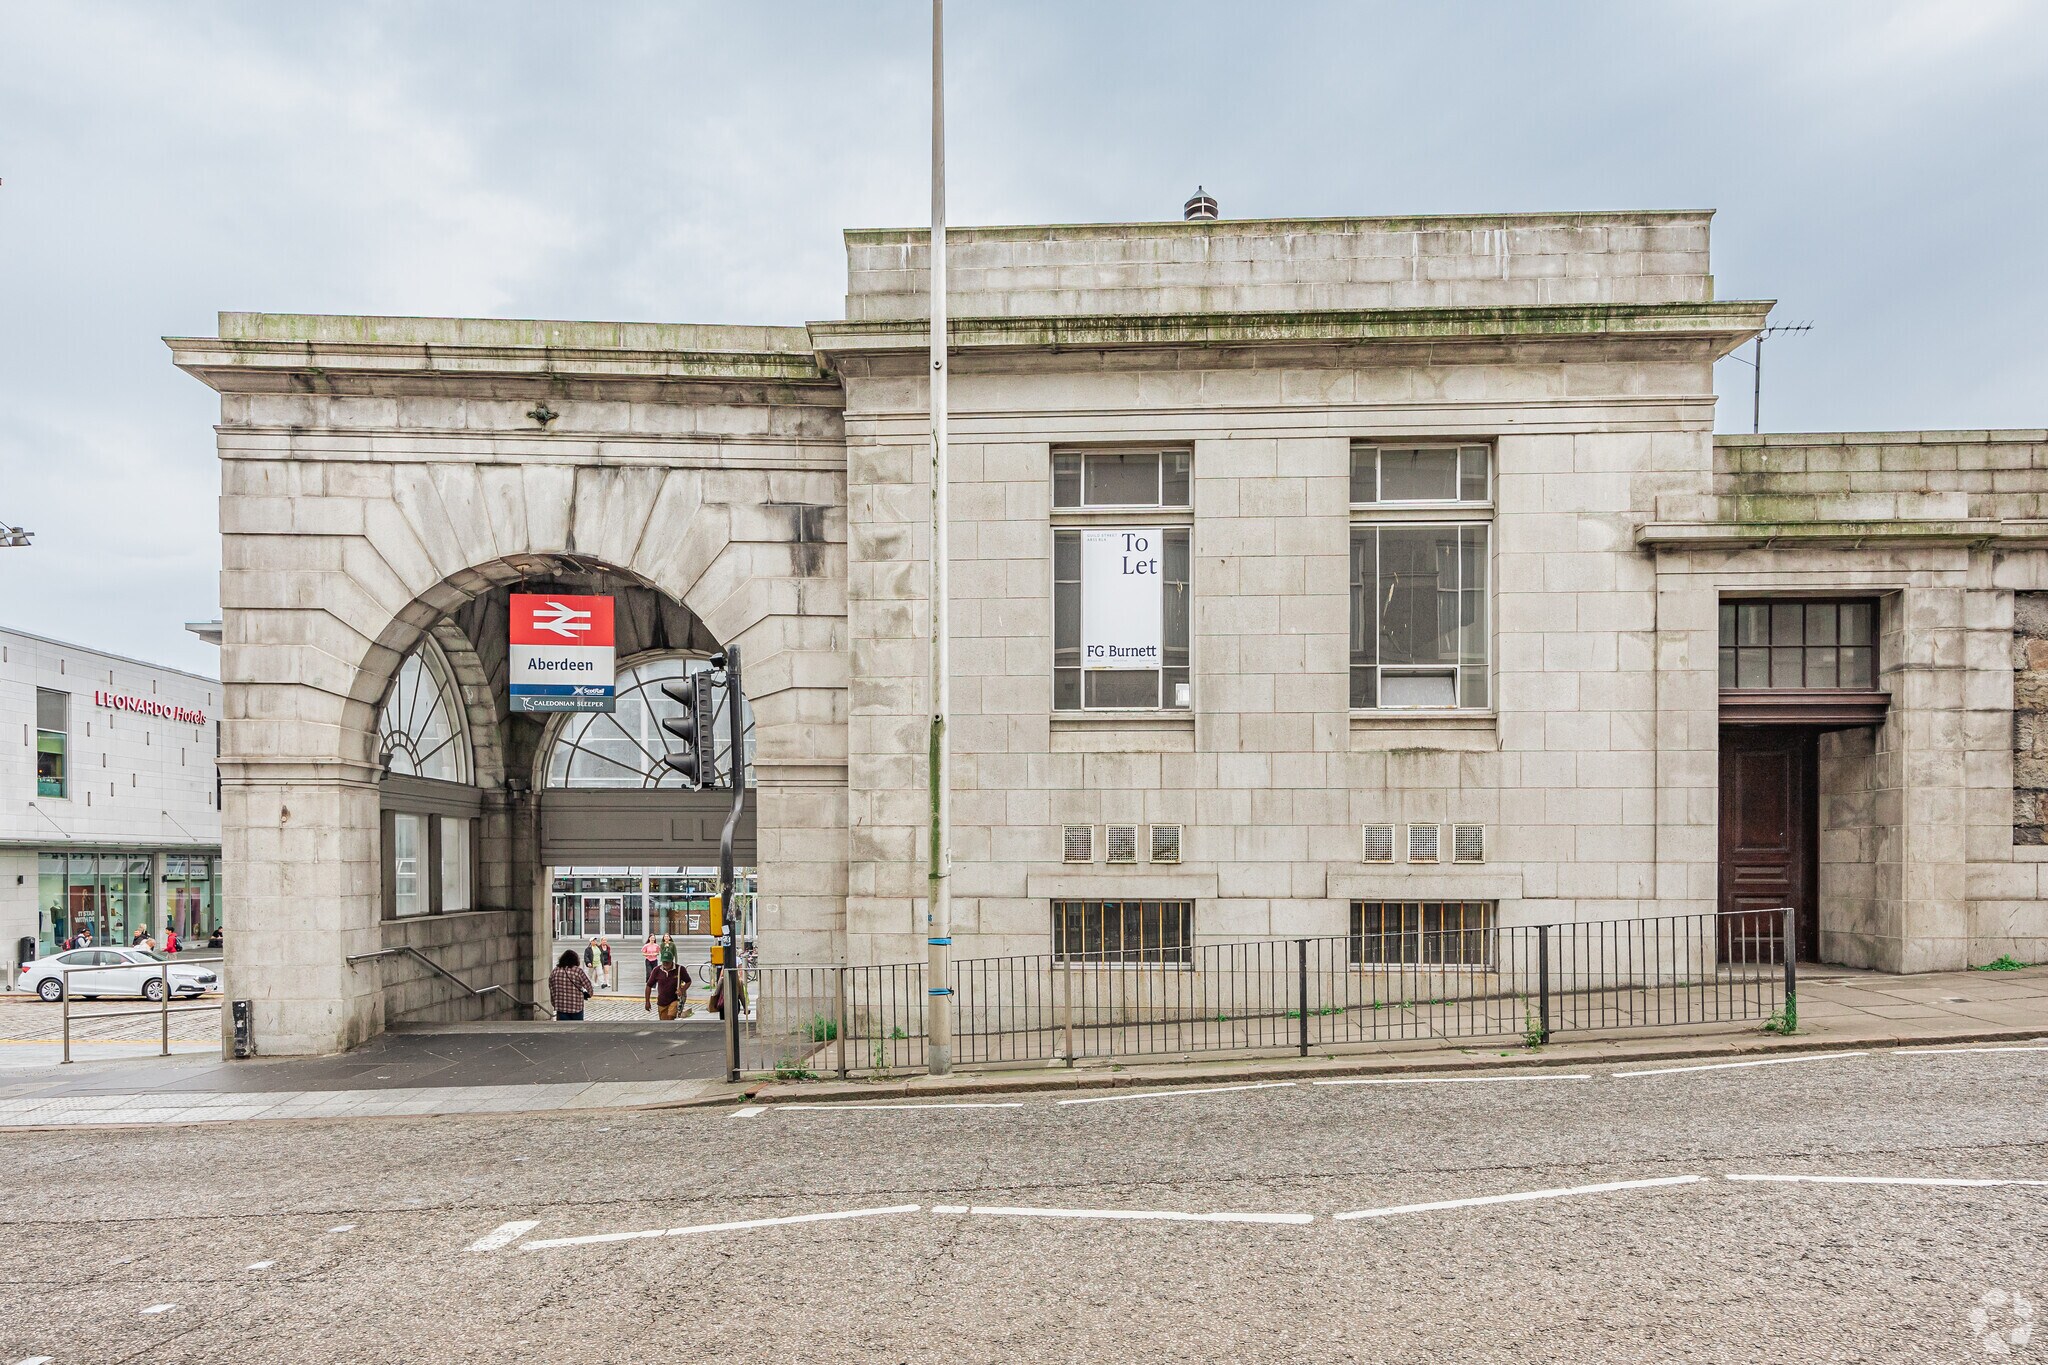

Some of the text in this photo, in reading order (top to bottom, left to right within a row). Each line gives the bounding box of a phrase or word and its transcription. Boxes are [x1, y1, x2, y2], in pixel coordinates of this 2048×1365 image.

[1121, 533, 1149, 552] To
[1122, 556, 1158, 575] Let
[1086, 645, 1157, 658] FG Burnett
[528, 657, 594, 671] Aberdeen
[95, 690, 207, 726] LEONARDO Hotels
